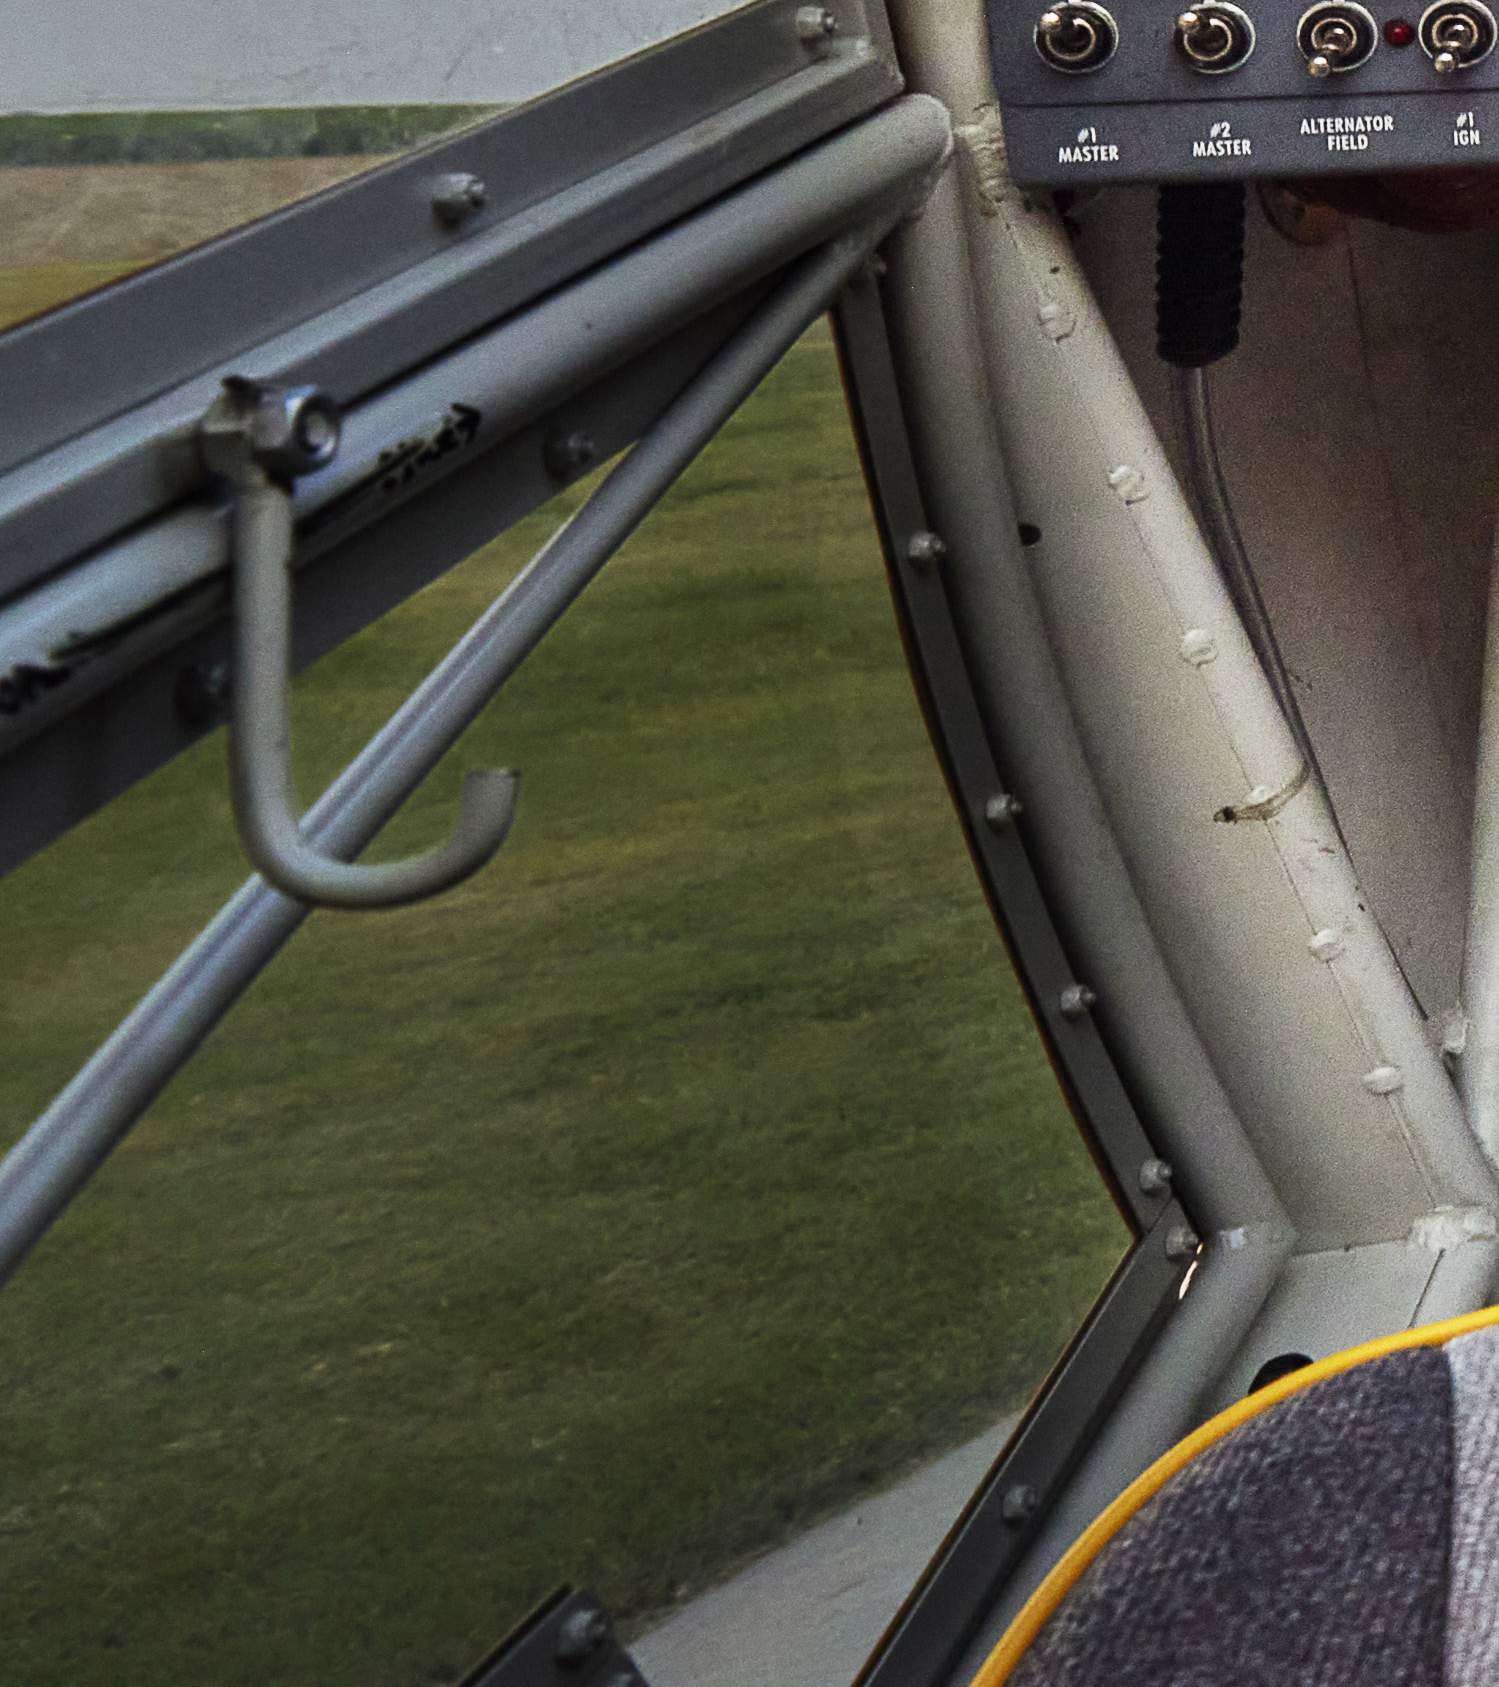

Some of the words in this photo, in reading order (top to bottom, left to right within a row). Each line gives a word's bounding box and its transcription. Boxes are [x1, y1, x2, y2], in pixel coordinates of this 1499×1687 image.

[1300, 116, 1393, 134] ALTERNATOR
[1456, 112, 1474, 127] #1
[1078, 127, 1097, 143] #1
[1211, 123, 1230, 138] #2
[1454, 130, 1480, 146] IGN
[1193, 140, 1251, 157] MASTER
[1328, 135, 1368, 151] FIELD
[1059, 146, 1118, 163] MASTER
